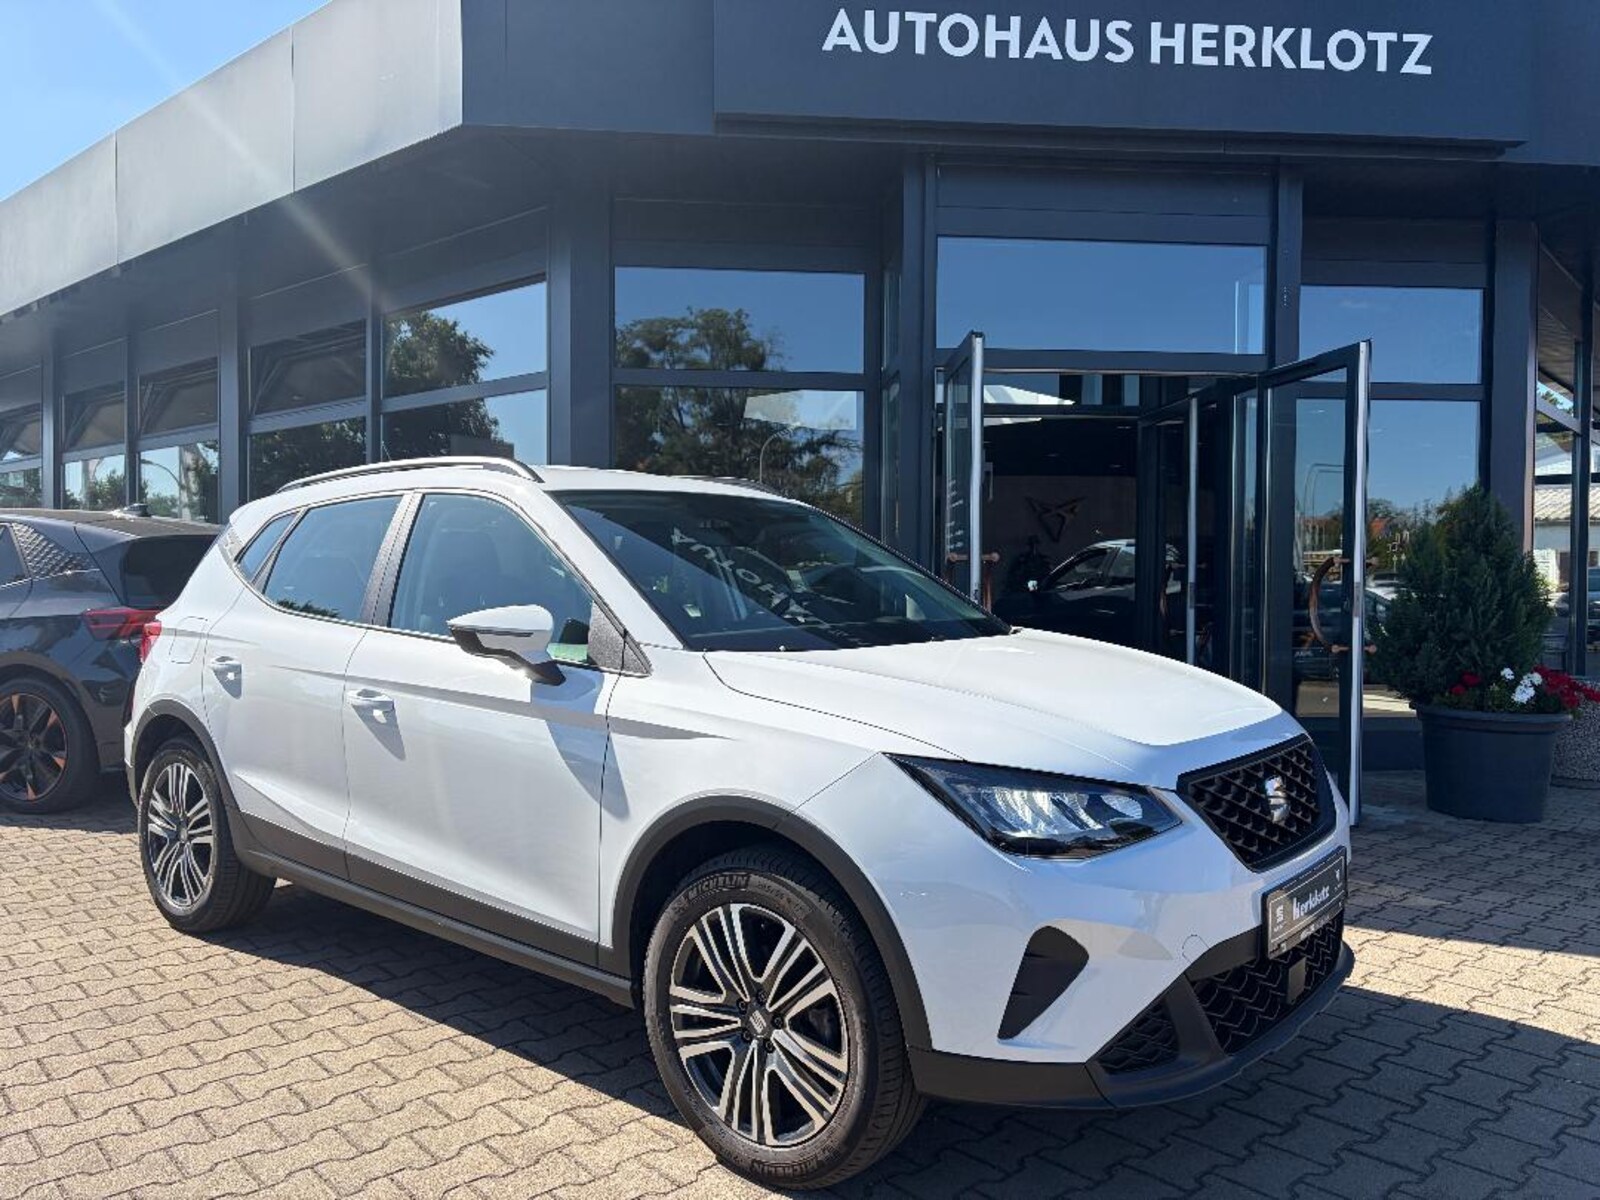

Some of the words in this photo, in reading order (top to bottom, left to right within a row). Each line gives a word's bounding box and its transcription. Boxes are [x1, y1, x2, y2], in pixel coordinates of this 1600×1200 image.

[822, 8, 1133, 63] AUTOHAUS
[1150, 22, 1432, 75] HERKLOTZ
[688, 874, 747, 899] MICHELIN
